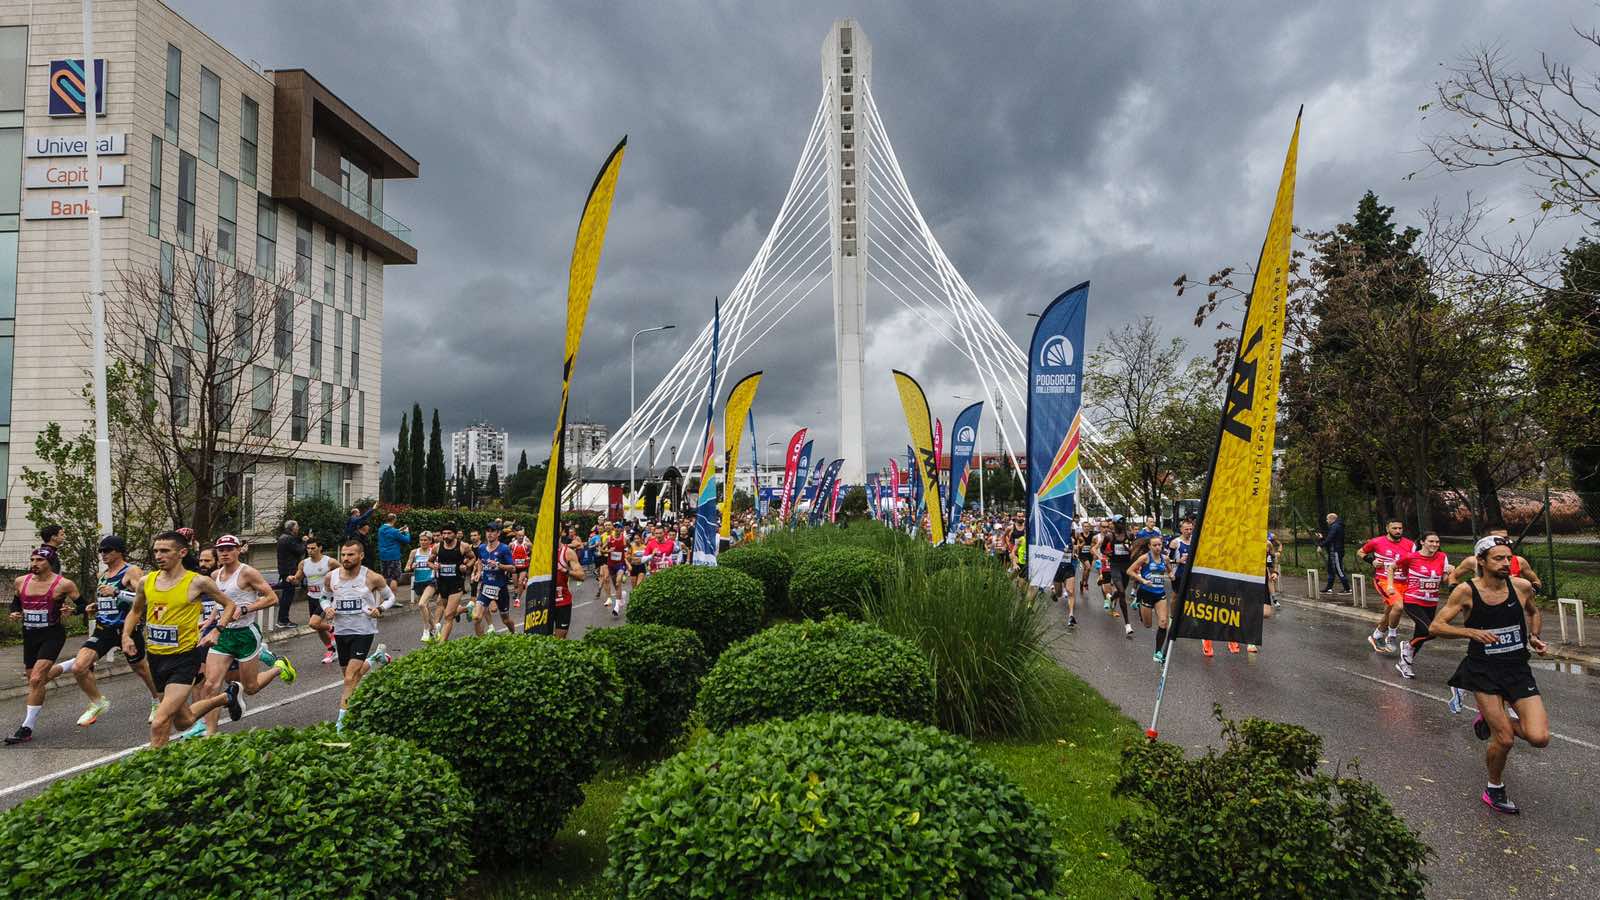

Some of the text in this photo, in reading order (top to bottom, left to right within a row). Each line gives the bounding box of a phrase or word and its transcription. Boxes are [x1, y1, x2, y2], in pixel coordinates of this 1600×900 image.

[47, 165, 102, 185] Capitl
[1036, 374, 1076, 386] PODGORICA
[1252, 267, 1281, 496] MULTISPORT AKADEMIJA MAYER
[153, 630, 168, 640] 827
